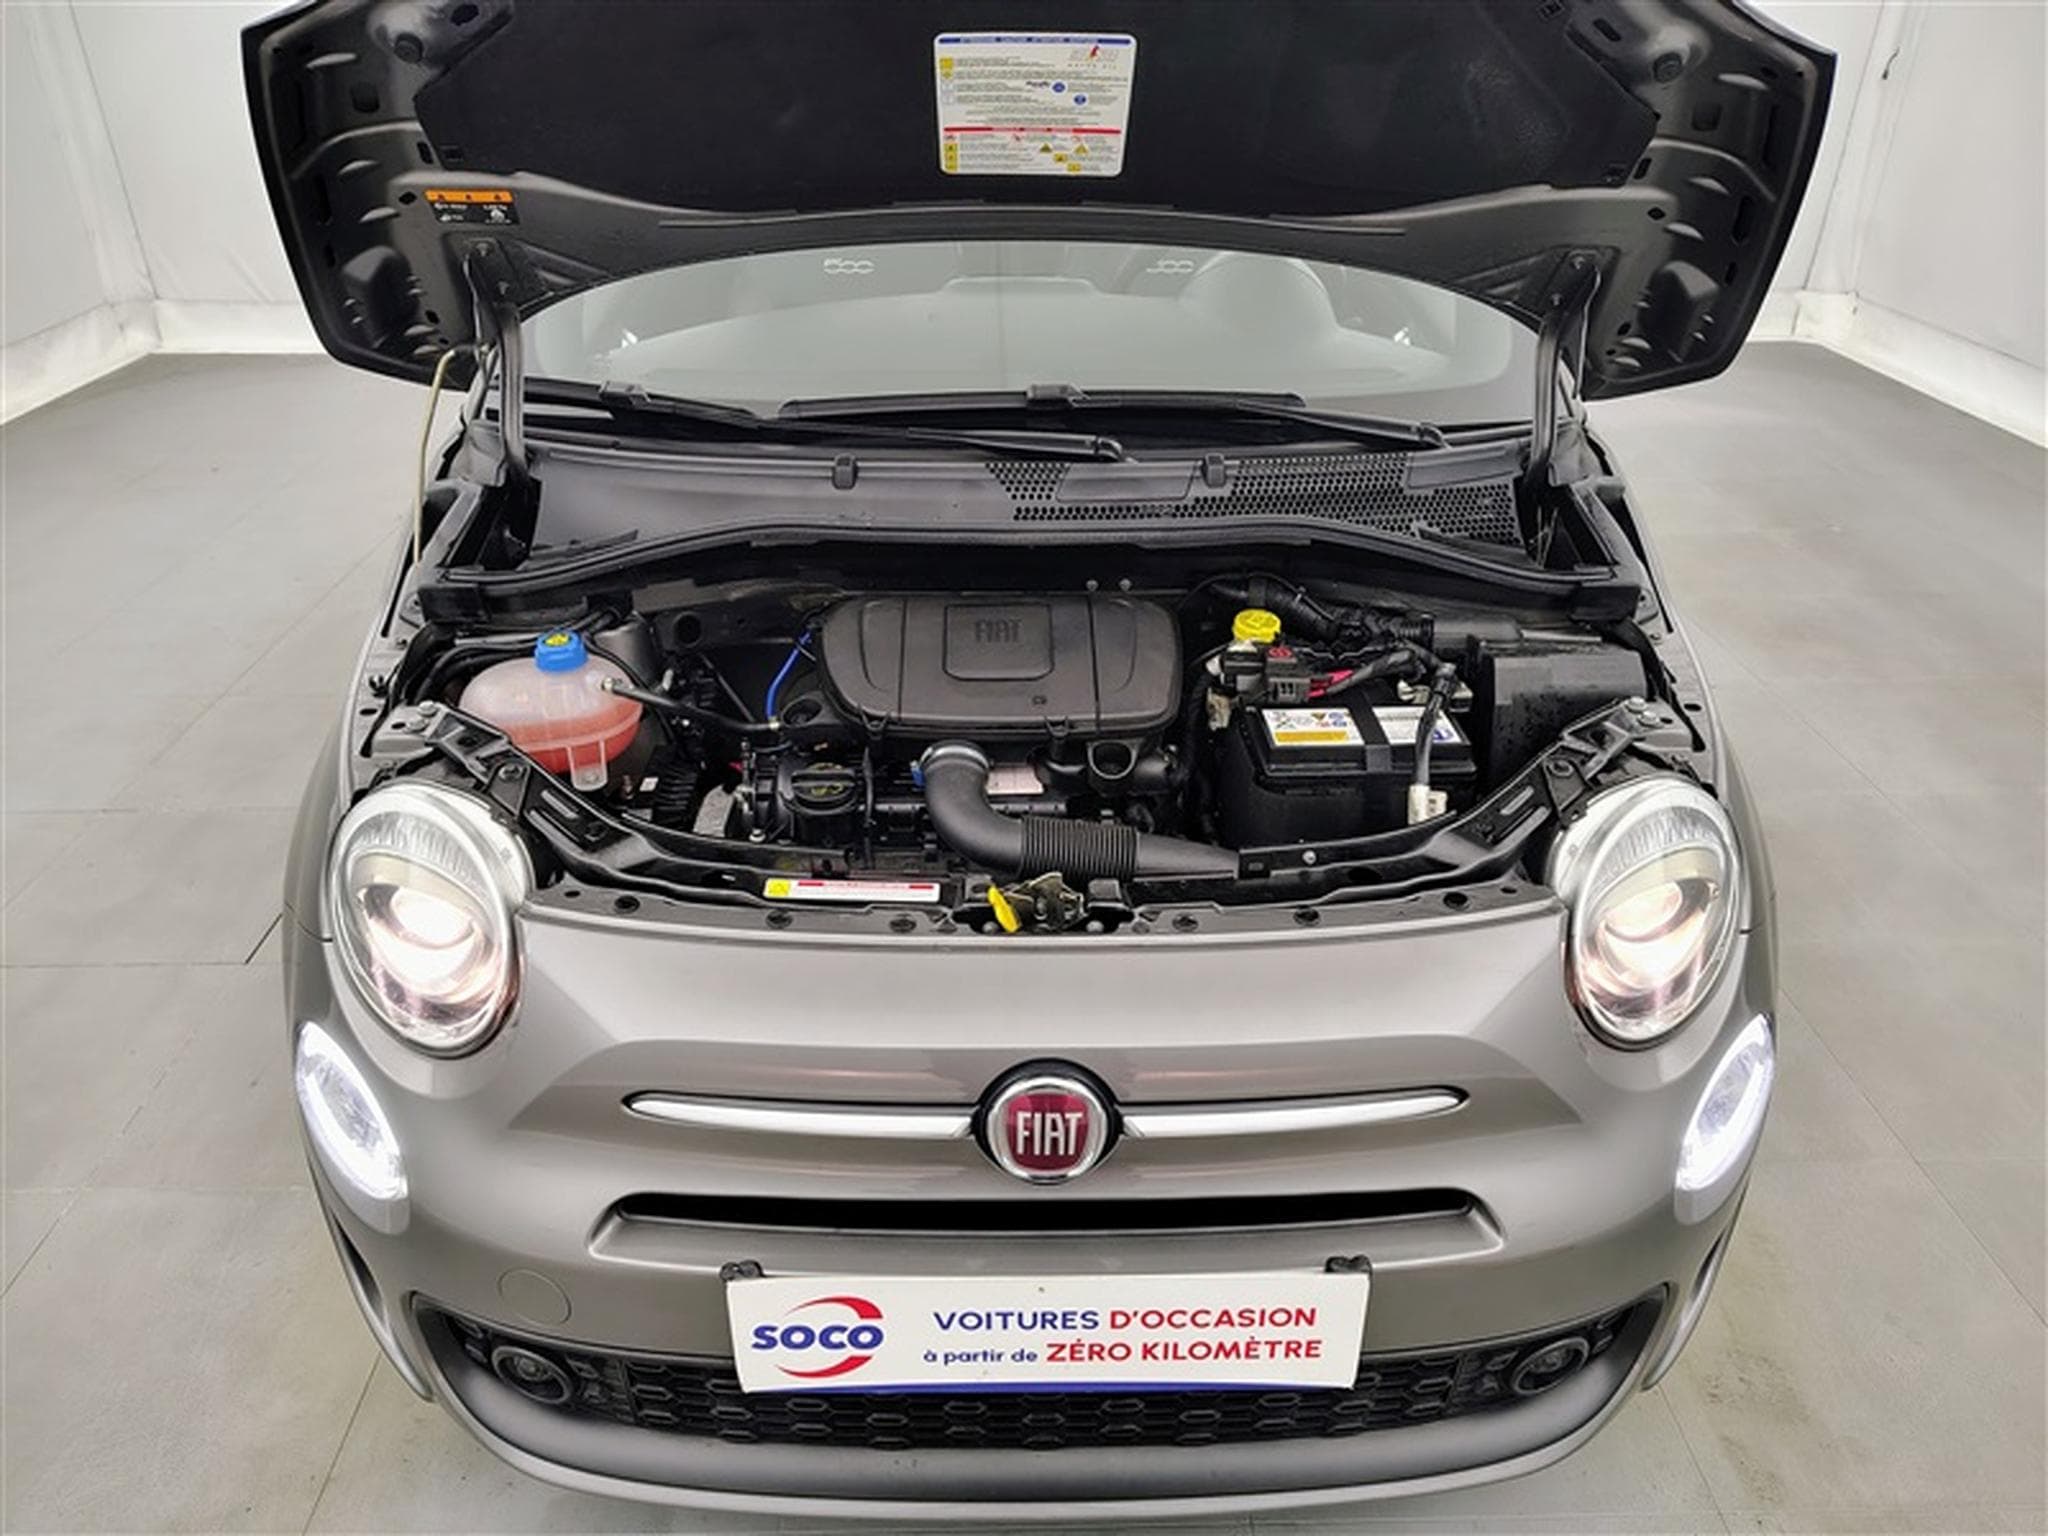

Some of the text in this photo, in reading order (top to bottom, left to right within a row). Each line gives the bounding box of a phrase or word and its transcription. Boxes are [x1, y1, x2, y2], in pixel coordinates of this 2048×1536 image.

[976, 619, 1022, 642] FIAT
[1017, 1111, 1083, 1155] FIAT
[933, 1308, 1316, 1331] VOITURES D'OCCASION
[752, 1325, 883, 1350] SOCO
[923, 1336, 1323, 1366] à partir de ZÉRO KILOMÈTRE
